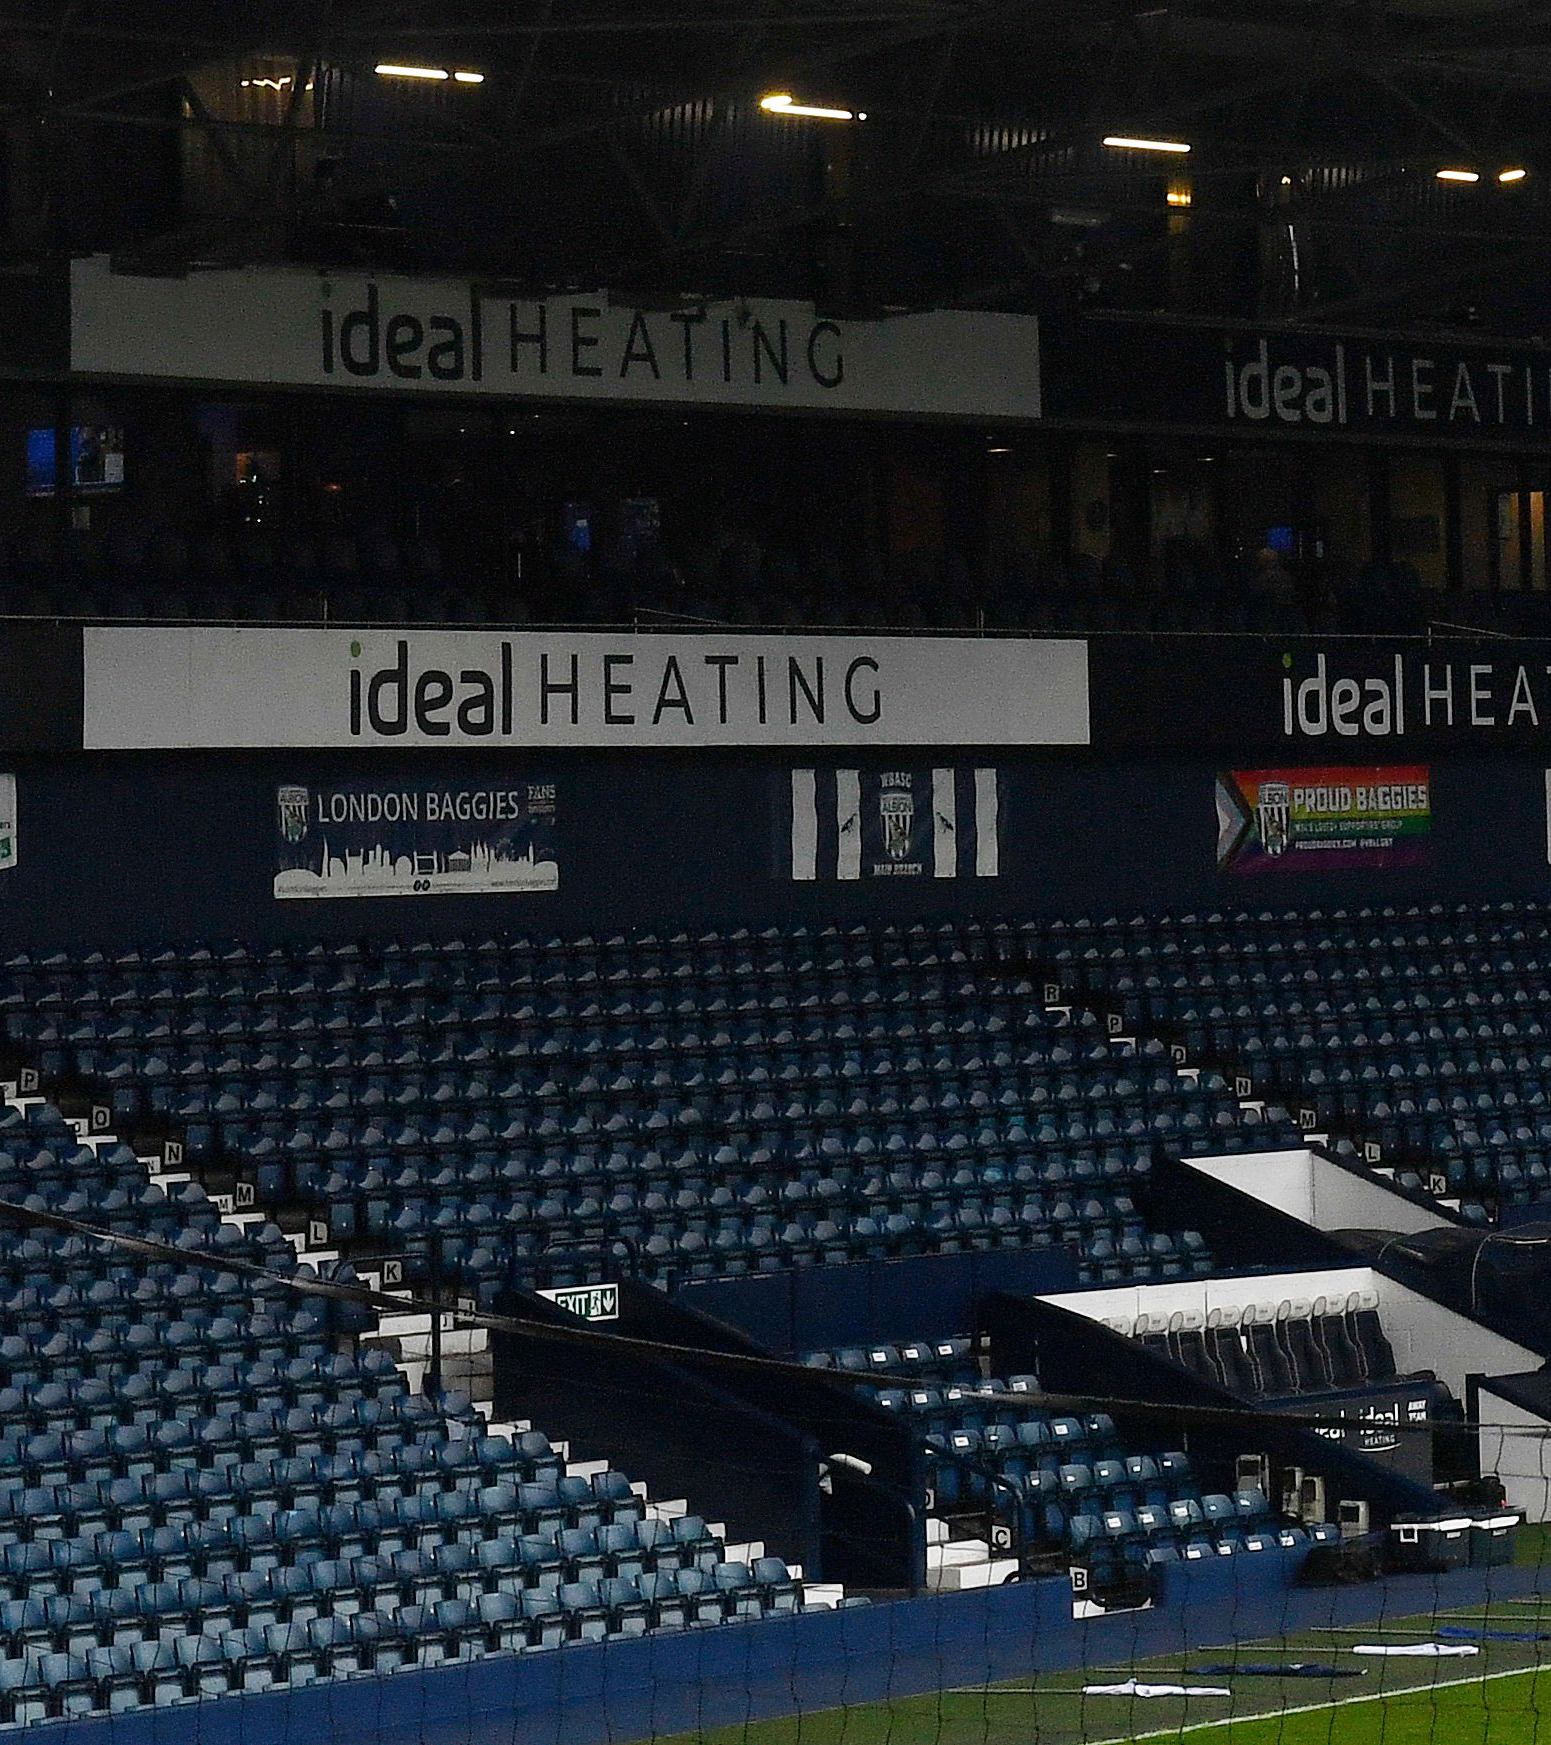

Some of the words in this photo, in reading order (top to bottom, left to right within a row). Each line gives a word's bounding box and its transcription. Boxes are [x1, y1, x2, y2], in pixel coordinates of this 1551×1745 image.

[319, 281, 484, 383] ideal
[509, 303, 846, 389] HEATING
[1224, 338, 1347, 425] ideal
[348, 638, 514, 737] ideal
[540, 653, 884, 726] HEATING
[1282, 652, 1404, 736] ideal
[526, 783, 557, 801] FANS
[1293, 786, 1351, 813] PROUD
[1356, 784, 1428, 812] BAGGIES
[317, 792, 419, 824] LONDON
[425, 790, 519, 822] BAGGIES
[168, 1144, 181, 1161] N
[238, 1185, 252, 1202] M
[386, 1263, 399, 1281] K
[556, 1293, 589, 1316] EXIT
[1363, 1434, 1397, 1446] HEATING
[1074, 1571, 1086, 1588] B
